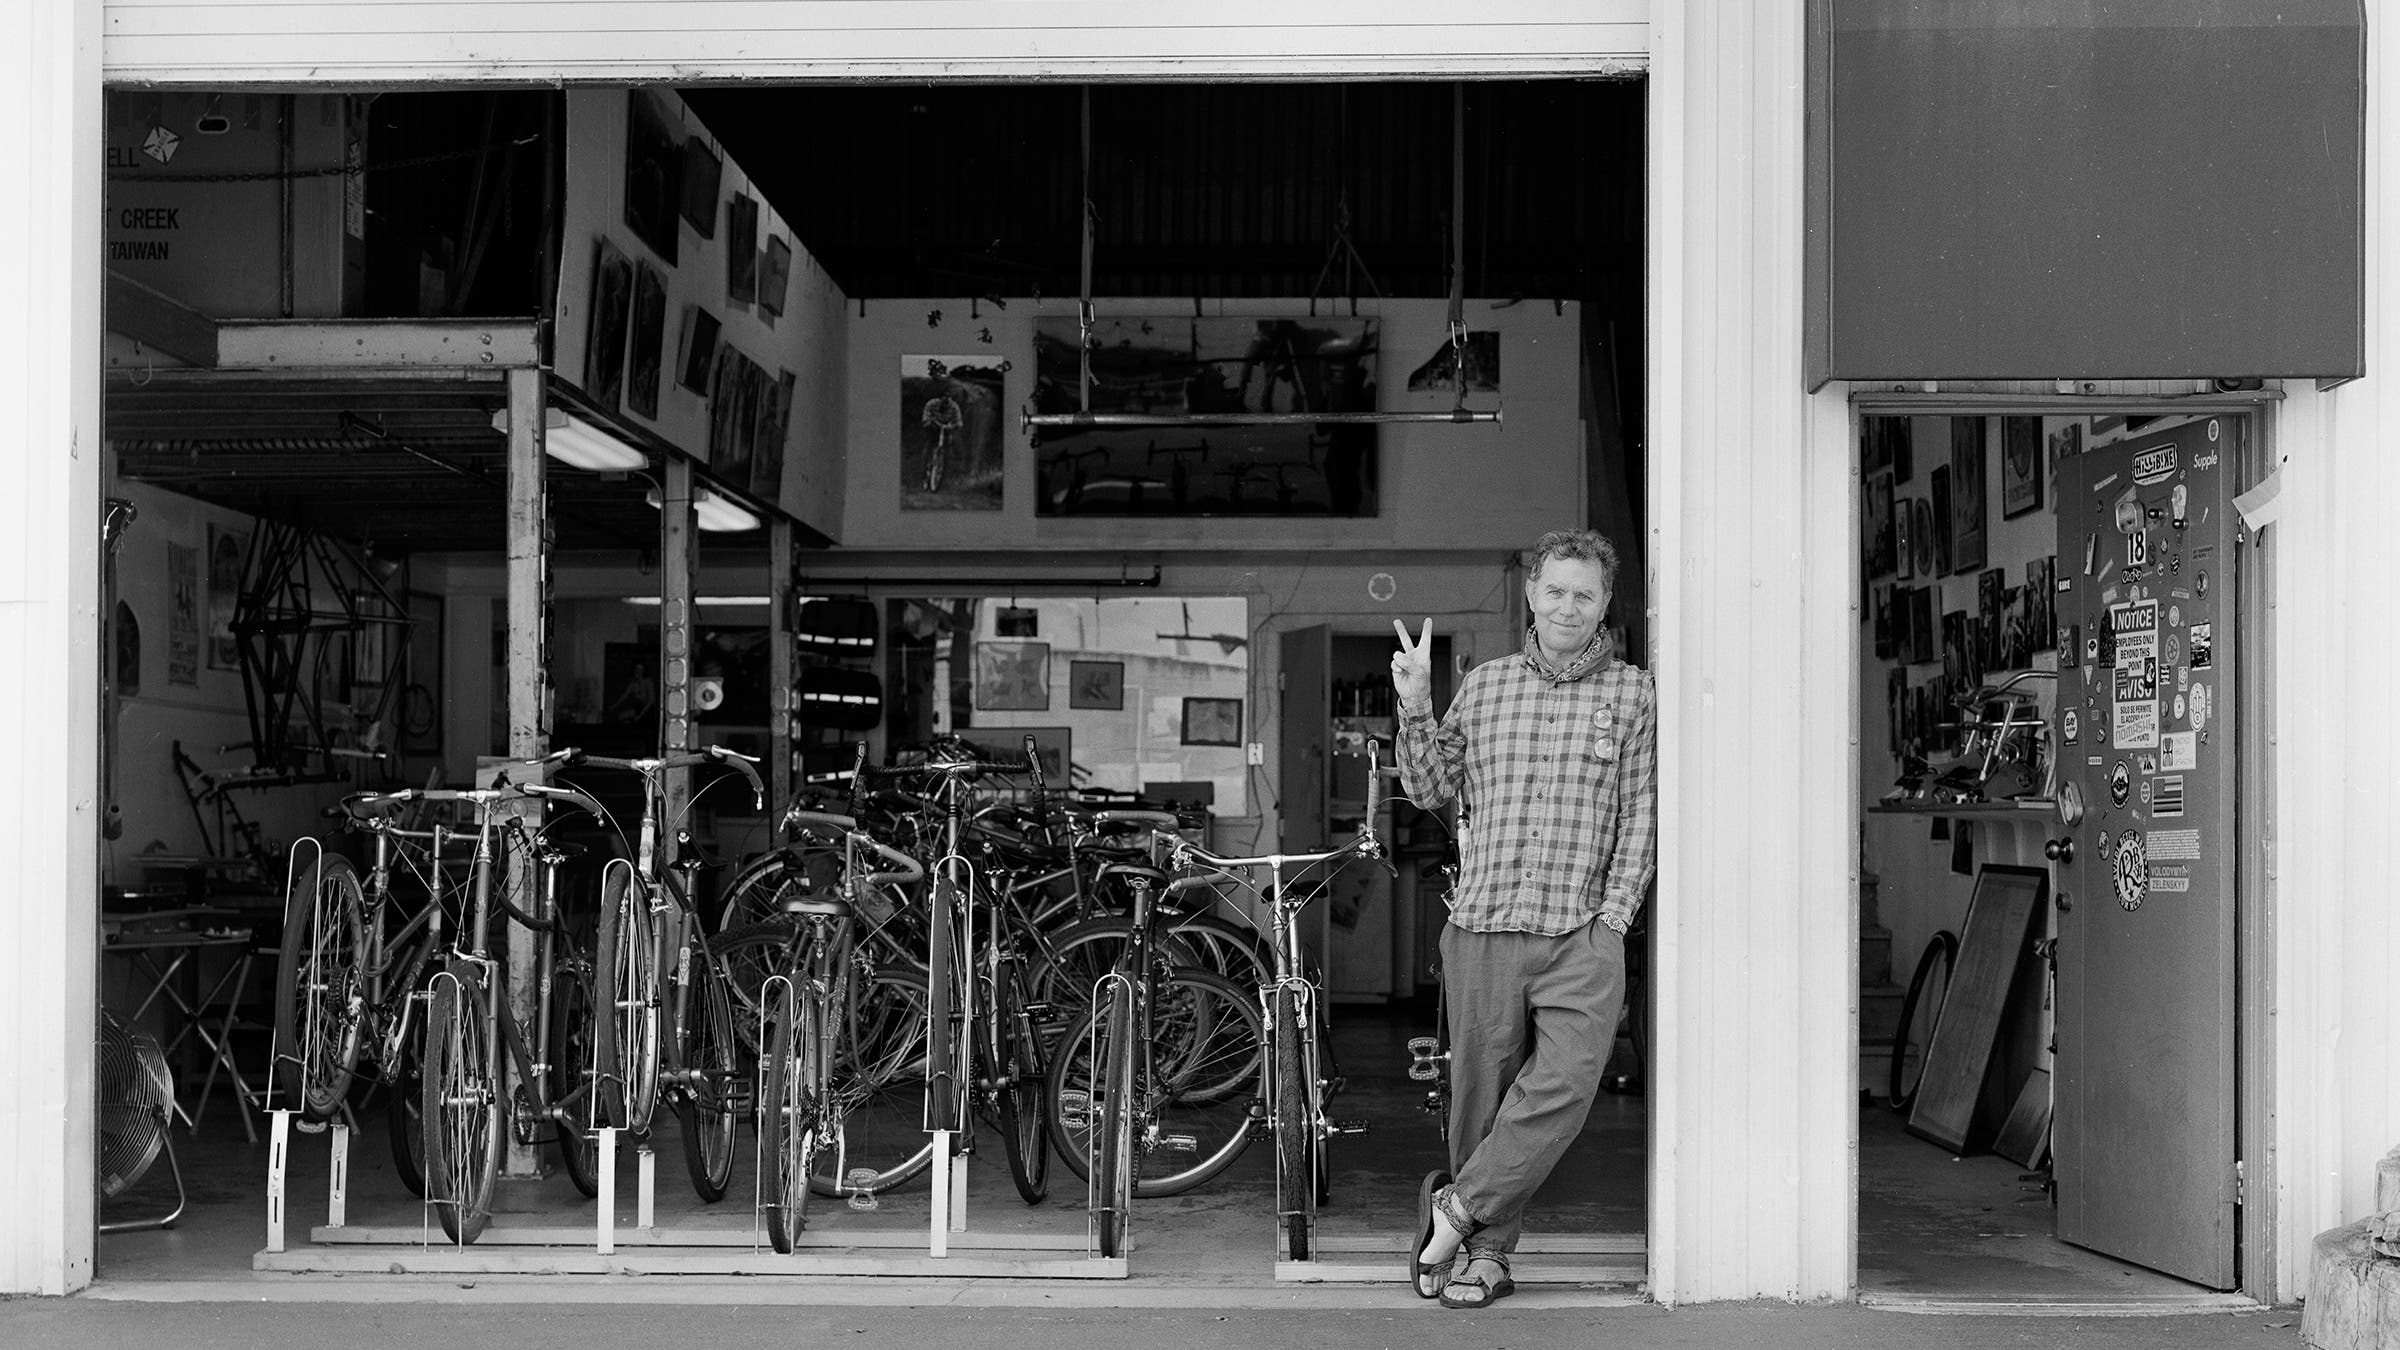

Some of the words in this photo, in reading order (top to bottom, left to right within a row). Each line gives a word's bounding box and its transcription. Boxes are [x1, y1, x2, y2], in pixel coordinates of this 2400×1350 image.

[121, 207, 180, 230] CREEK
[110, 241, 169, 260] TAIWAN
[2193, 449, 2218, 470] Supple
[2129, 531, 2145, 564] 18
[2117, 608, 2153, 630] NOTICE
[2115, 635, 2142, 648] EMPLOYEES
[2142, 634, 2155, 646] ONLY
[2120, 648, 2139, 660] BEYOND
[2139, 647, 2151, 658] THIS
[2128, 661, 2142, 671] POINT
[2152, 879, 2185, 889] ZELENSKYY
